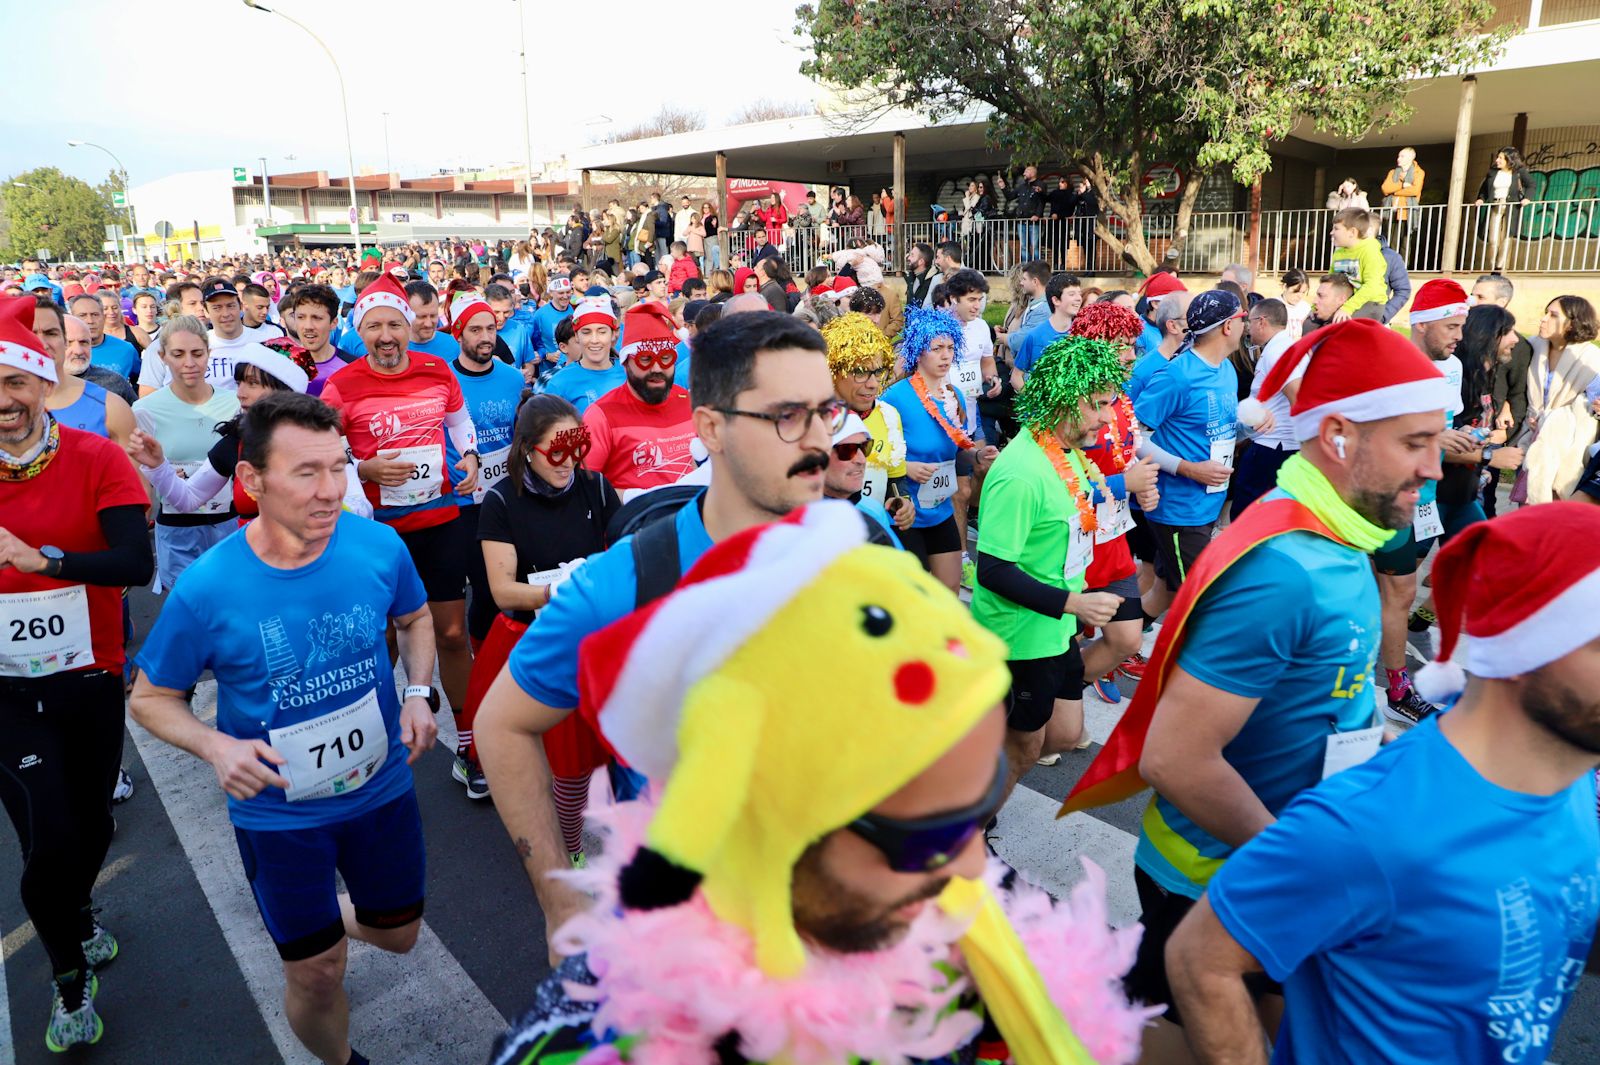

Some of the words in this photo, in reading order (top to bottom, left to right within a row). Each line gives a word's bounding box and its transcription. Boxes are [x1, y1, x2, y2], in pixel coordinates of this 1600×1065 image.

[960, 371, 976, 383] 320
[555, 425, 589, 440] HAPPY
[862, 480, 873, 496] 5
[9, 614, 65, 642] 260
[271, 681, 302, 703] SAN
[279, 670, 377, 711] CORDOBESA
[308, 728, 365, 770] 710
